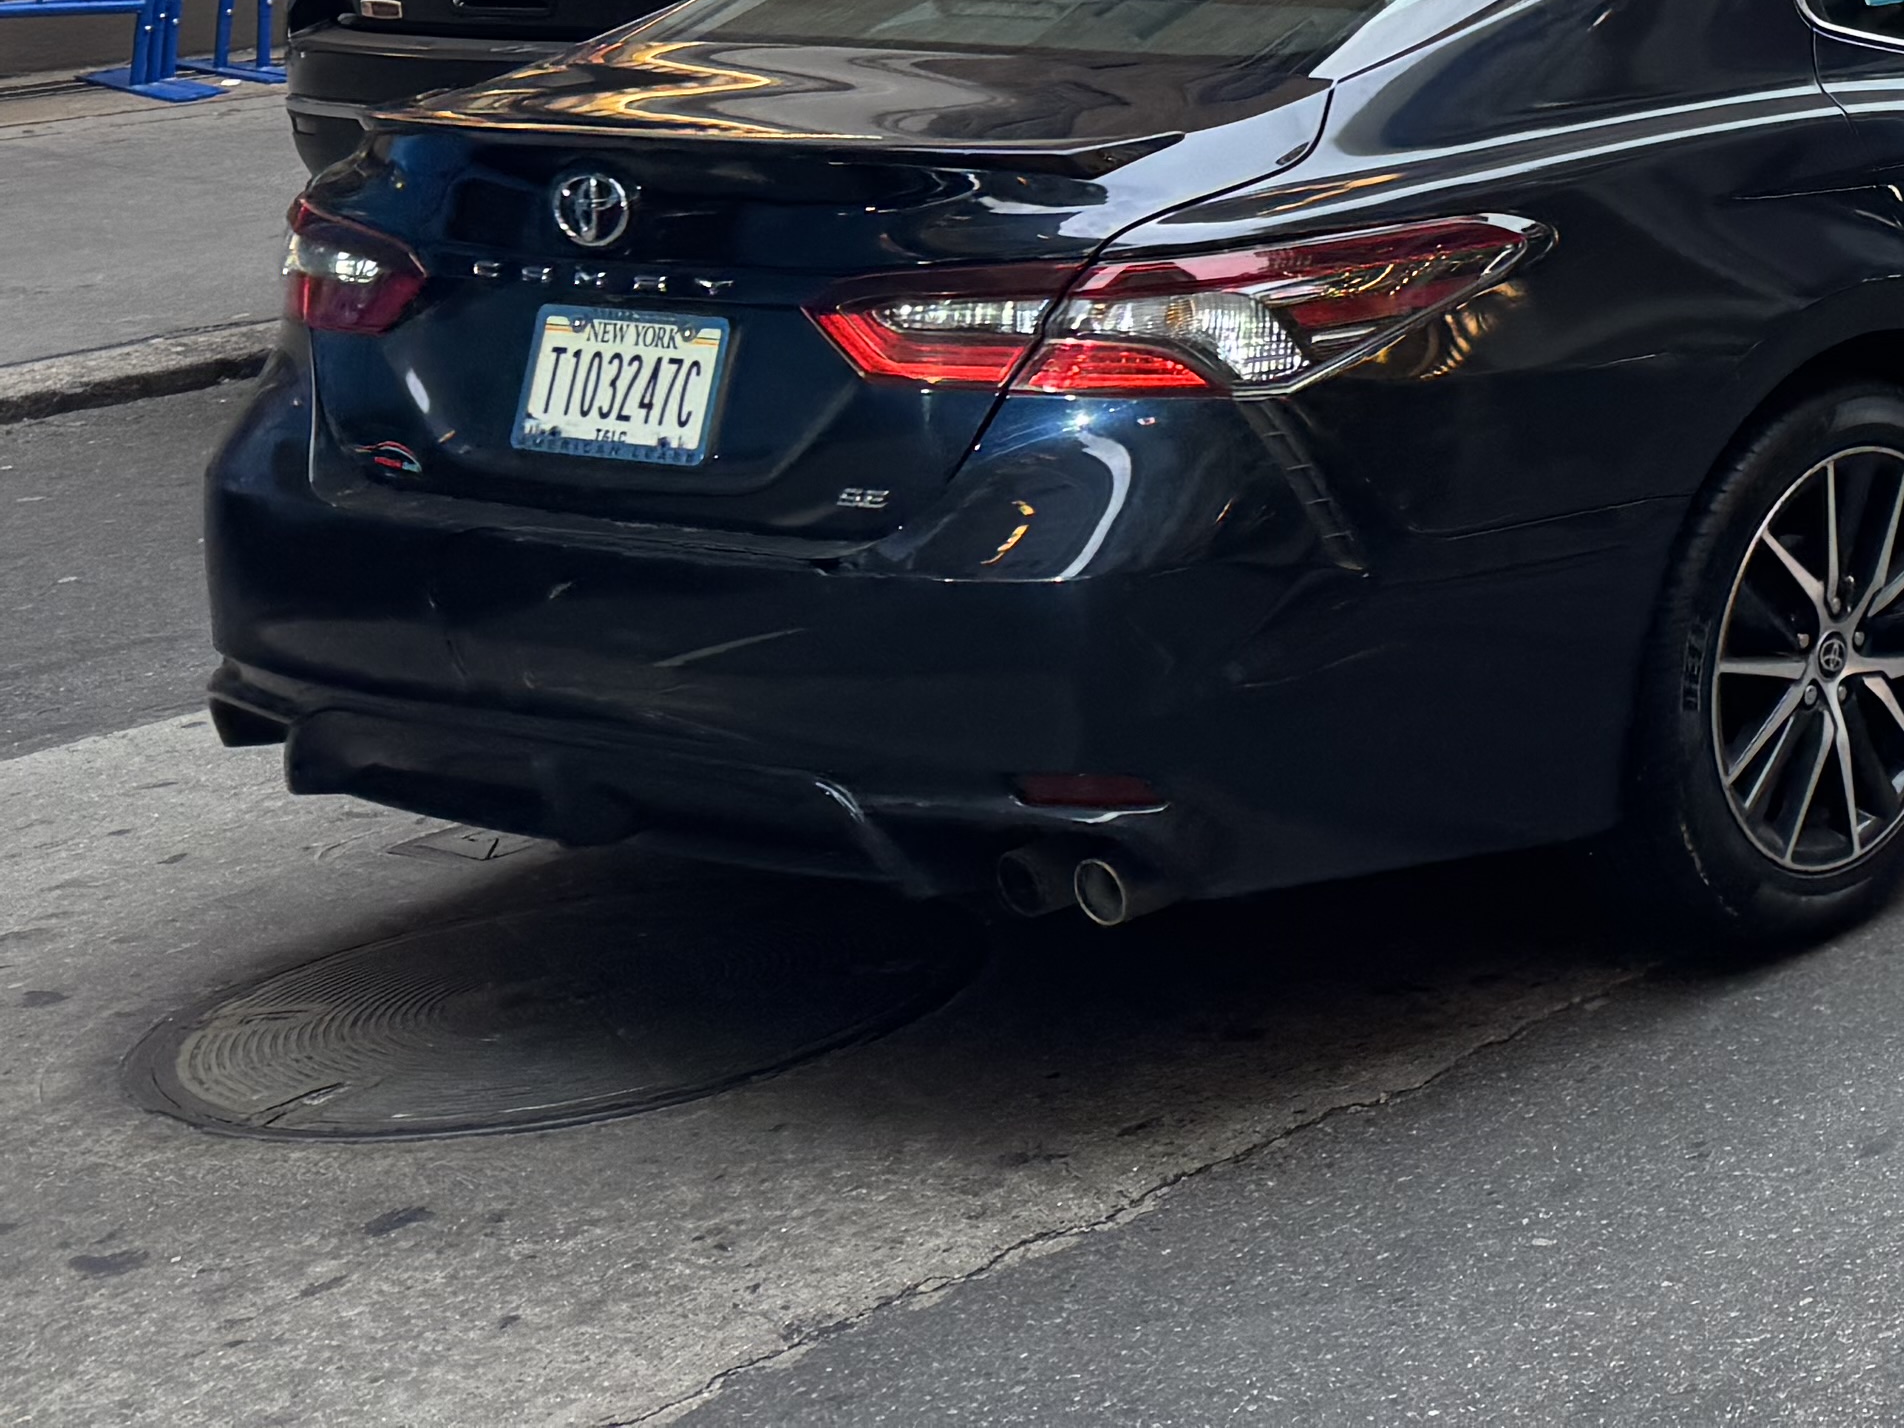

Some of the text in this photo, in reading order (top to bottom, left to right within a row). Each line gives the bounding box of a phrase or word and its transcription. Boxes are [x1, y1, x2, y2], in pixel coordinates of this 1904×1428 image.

[472, 258, 737, 296] CAMRY
[586, 322, 679, 351] NEW YORK
[543, 346, 702, 429] T103247C
[836, 487, 891, 510] SE
